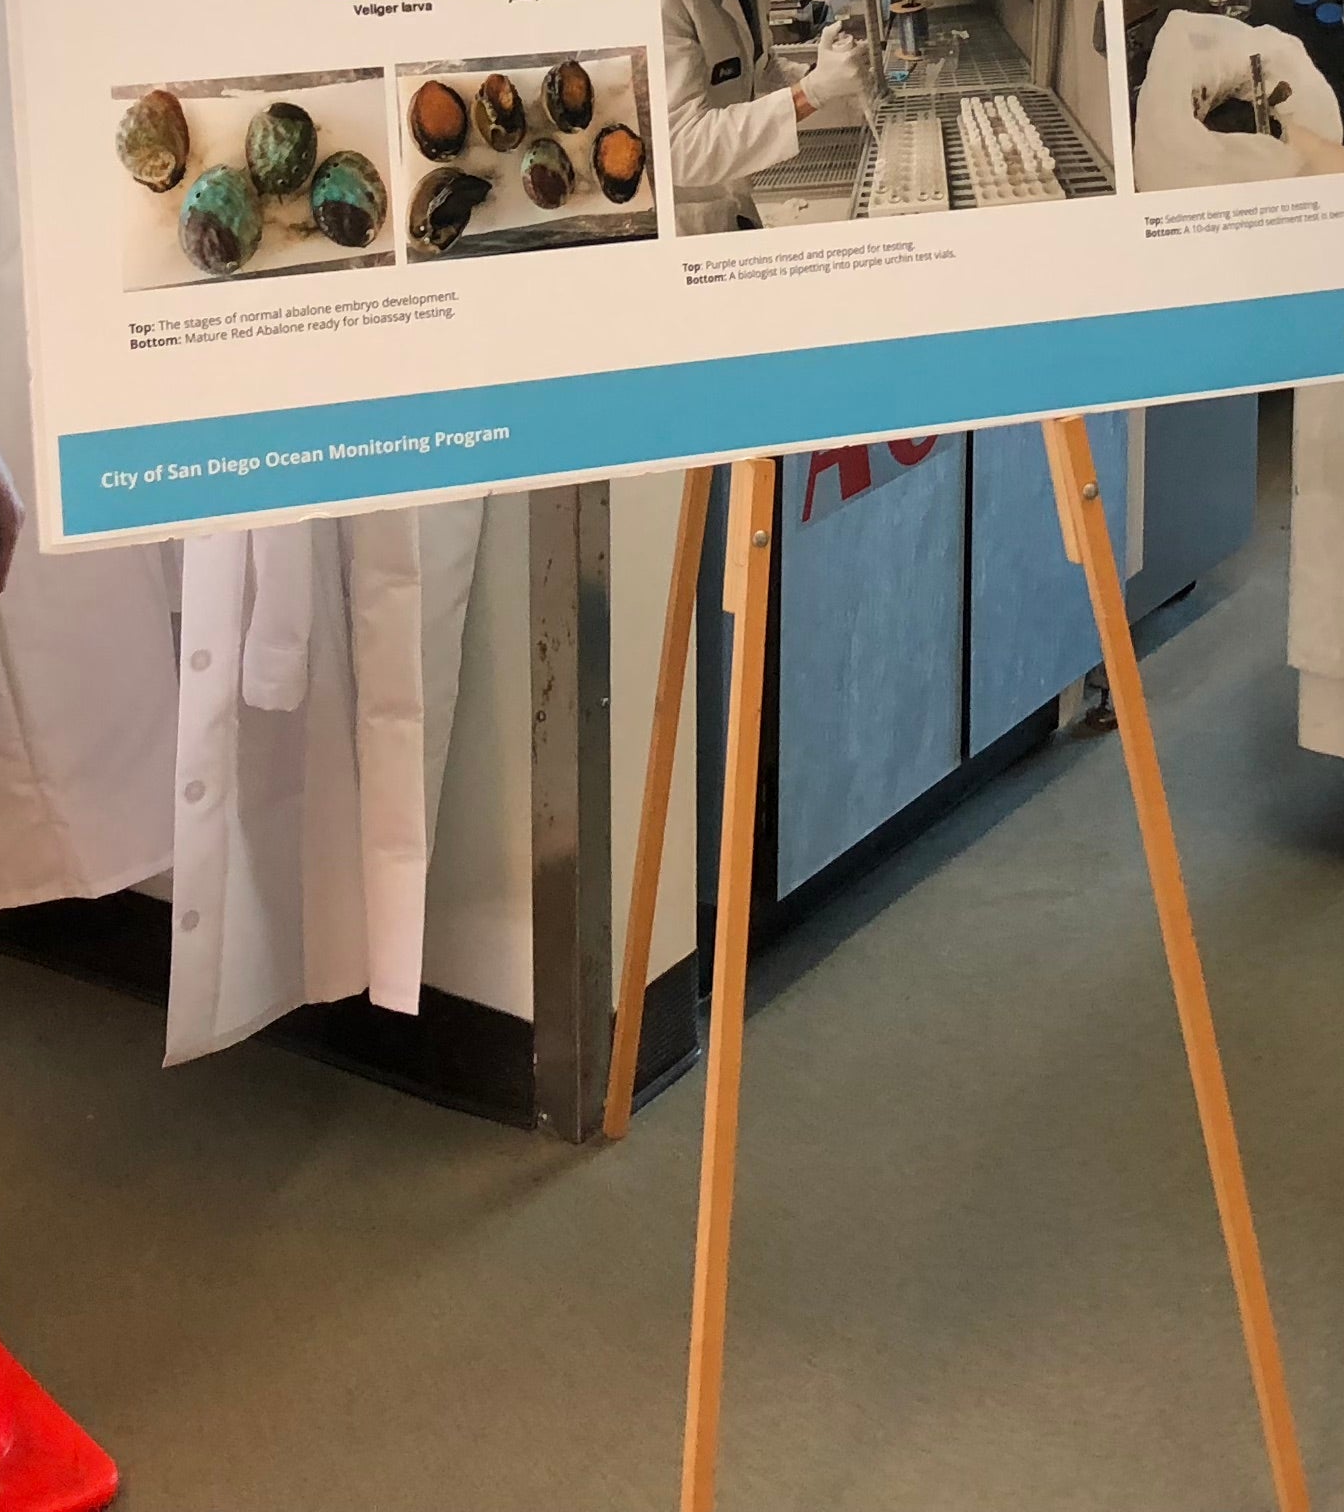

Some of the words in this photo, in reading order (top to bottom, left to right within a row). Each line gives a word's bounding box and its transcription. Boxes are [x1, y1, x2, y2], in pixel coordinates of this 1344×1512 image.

[352, 2, 399, 17] Veliger
[400, 1, 433, 13] larva
[127, 322, 156, 337] Top:
[157, 318, 182, 332] The
[182, 315, 223, 331] stages
[223, 311, 238, 325] of
[238, 306, 283, 323] normal
[284, 304, 333, 319] abalone
[333, 299, 380, 314] embryo
[380, 290, 460, 309] development.
[129, 335, 182, 351] Bottom:
[183, 330, 228, 344] Mature
[230, 325, 254, 340] Red
[254, 321, 305, 337] Abalone
[306, 317, 341, 332] ready
[341, 315, 360, 328] for
[361, 311, 412, 326] bioassay
[413, 306, 456, 321] testing.
[100, 470, 139, 491] City
[143, 463, 164, 484] of
[166, 462, 203, 481] San
[206, 456, 261, 476] Diego
[264, 448, 324, 468] Ocean
[328, 434, 431, 460] Monitoring
[434, 425, 510, 449] Program
